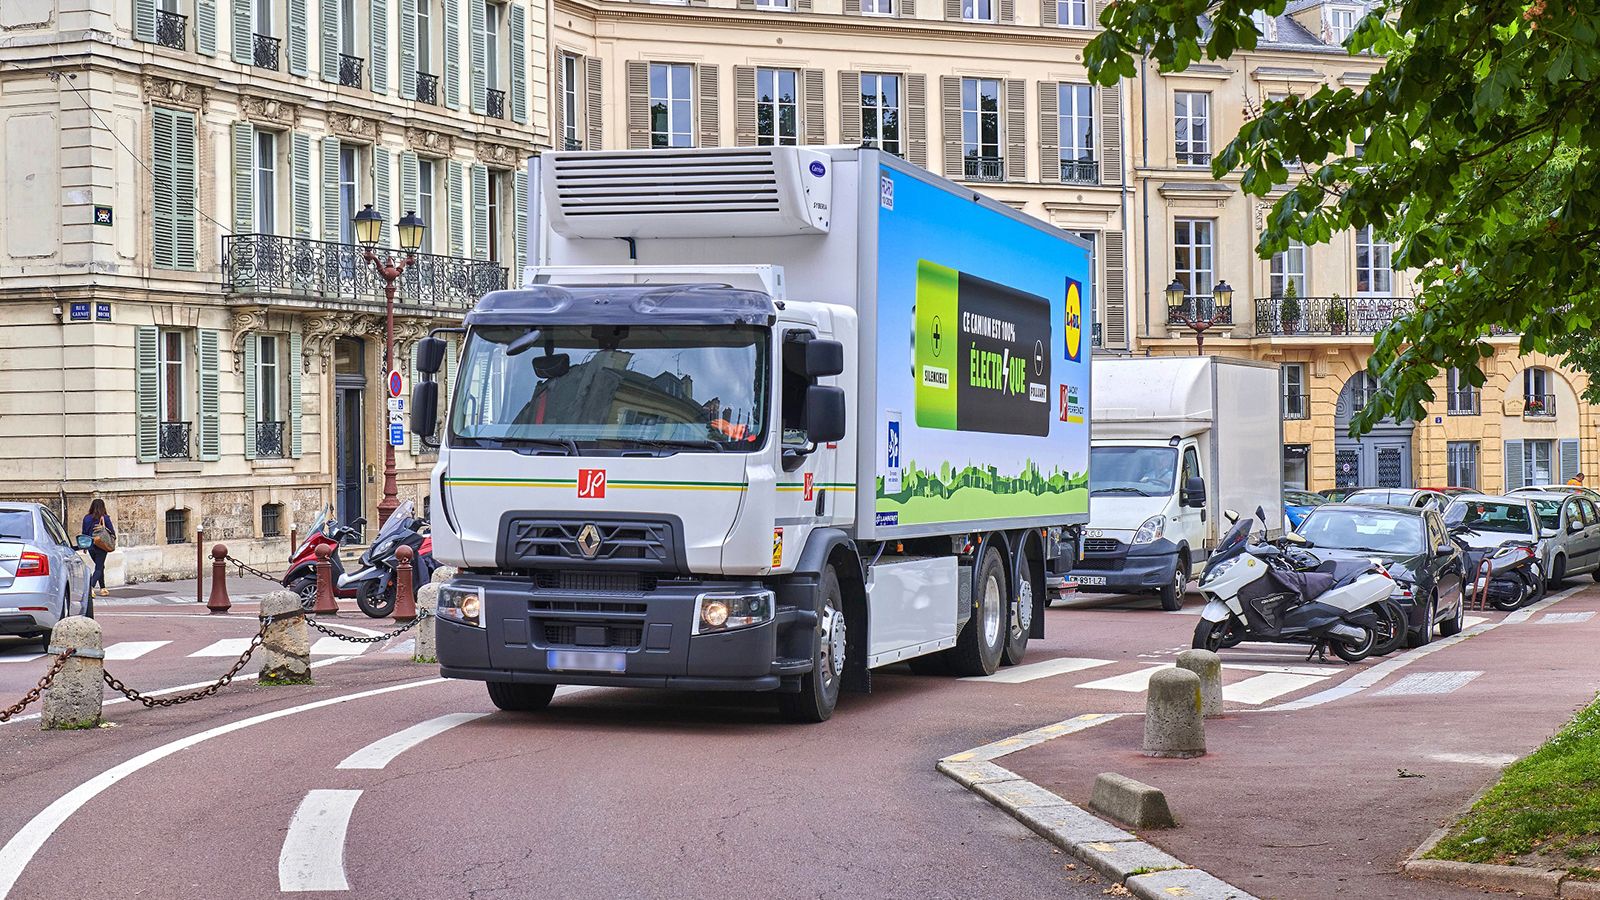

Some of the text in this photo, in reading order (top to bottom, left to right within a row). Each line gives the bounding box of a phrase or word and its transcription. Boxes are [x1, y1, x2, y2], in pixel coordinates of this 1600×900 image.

[962, 311, 1016, 343] CE CAMION EST 100%
[924, 369, 948, 385] SILENCIEUX
[1030, 386, 1046, 399] POLLUANT
